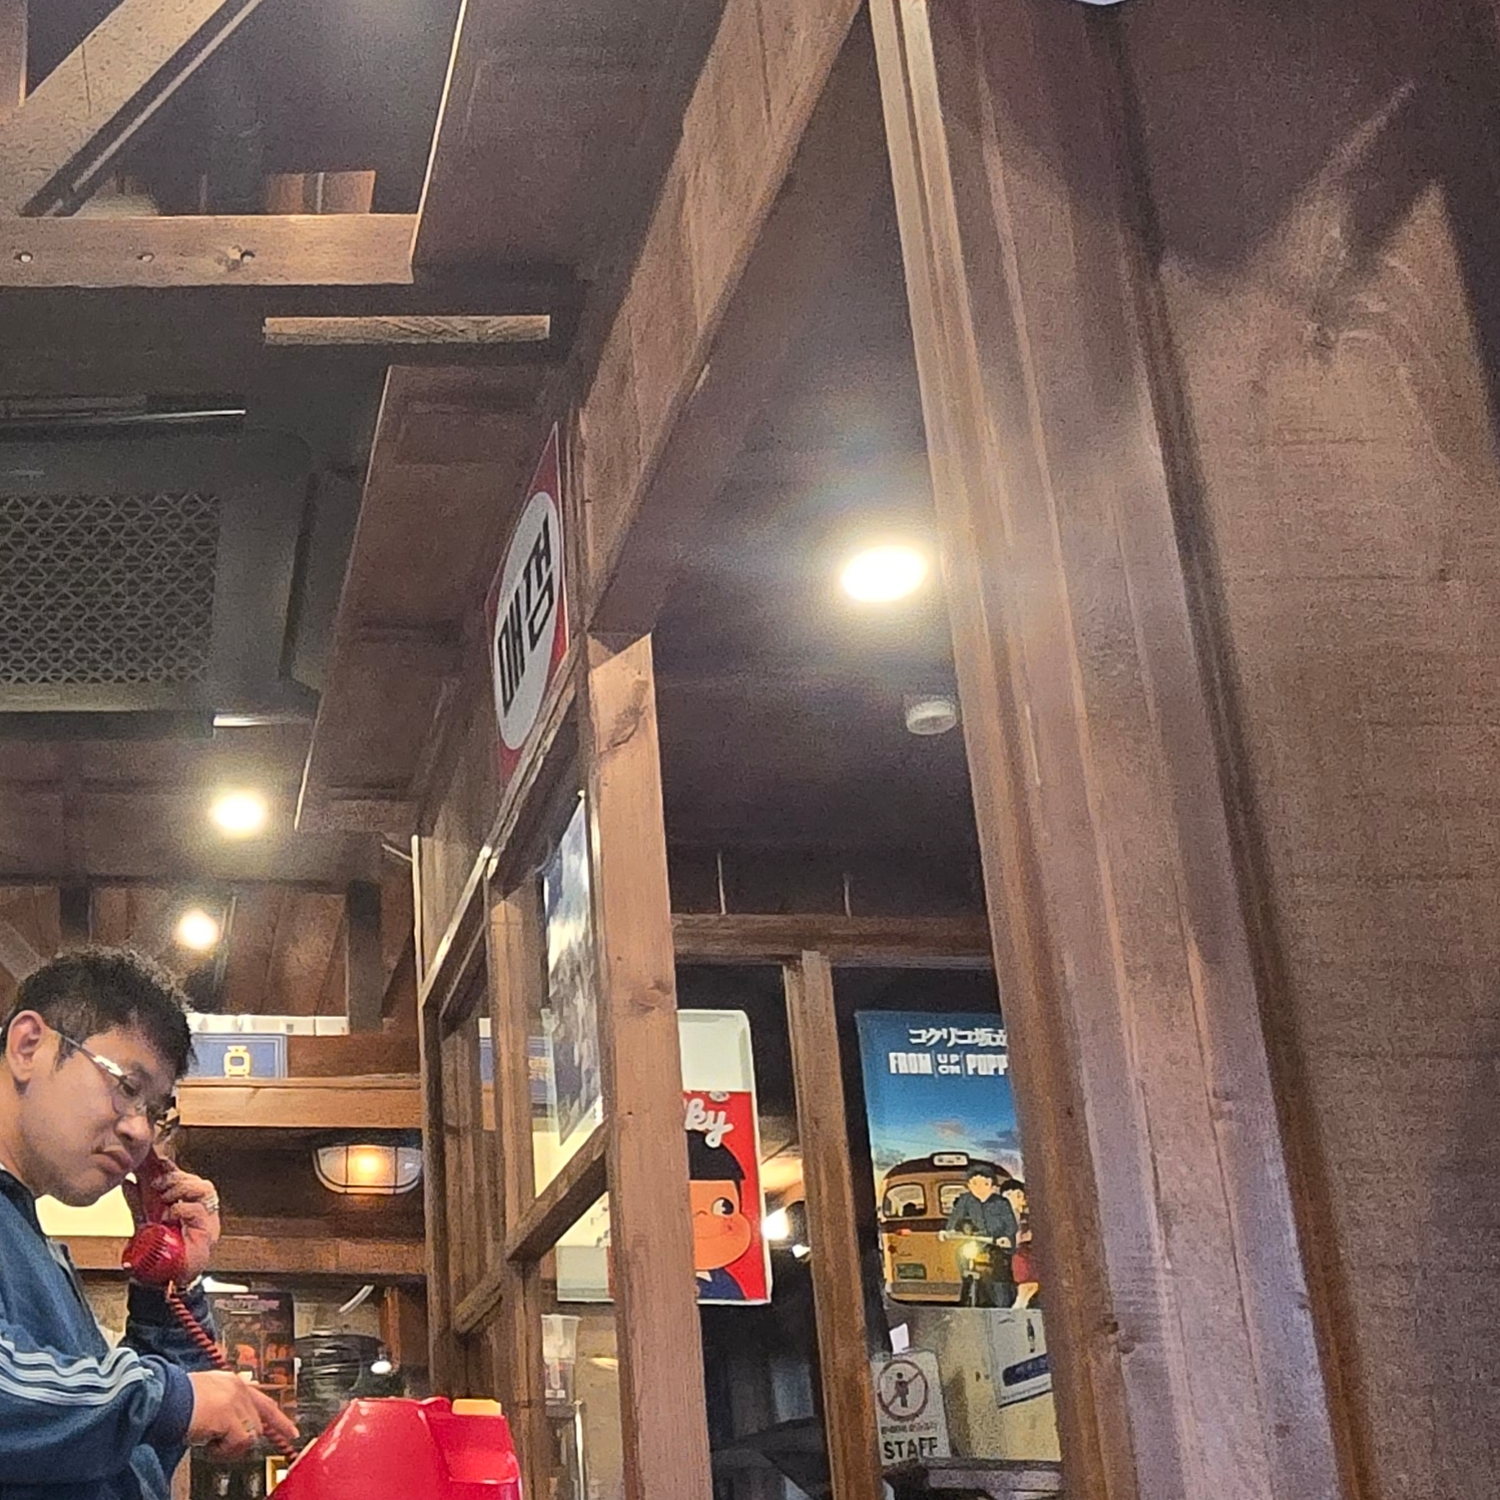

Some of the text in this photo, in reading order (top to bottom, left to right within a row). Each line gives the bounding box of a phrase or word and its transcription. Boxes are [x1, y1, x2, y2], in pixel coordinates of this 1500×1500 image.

[497, 513, 554, 717] 매점
[889, 1052, 933, 1074] FROM
[883, 1437, 938, 1460] STAFF
